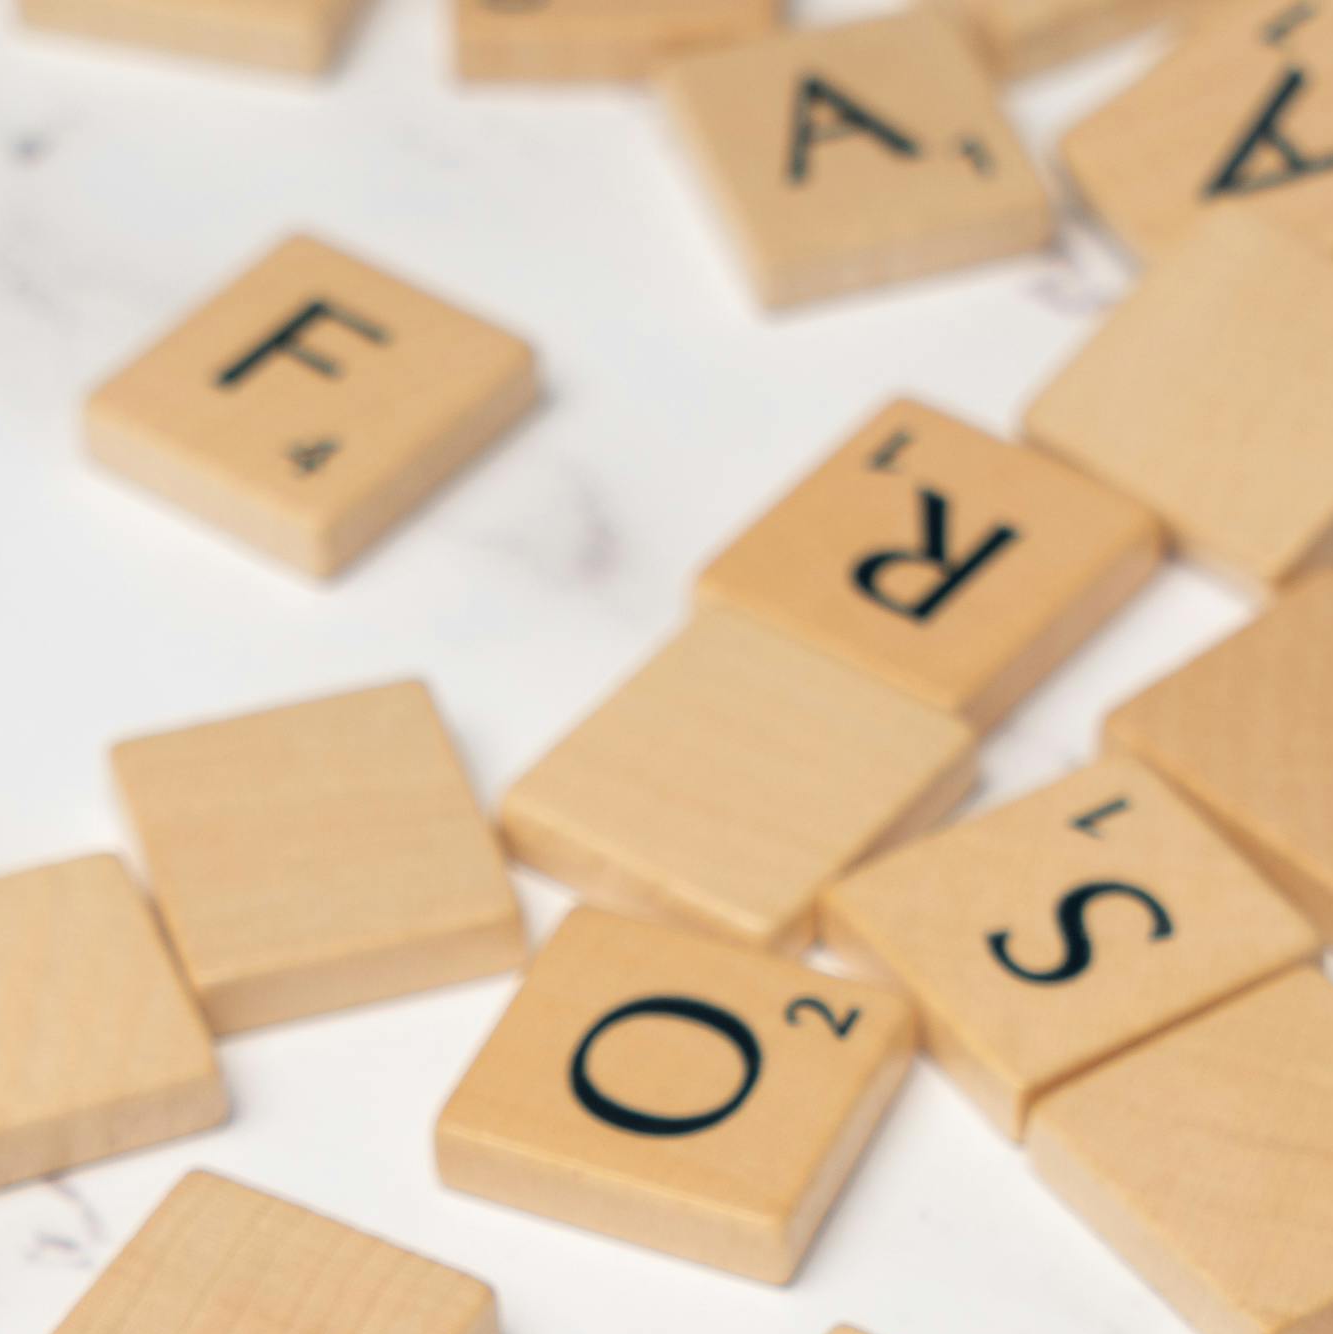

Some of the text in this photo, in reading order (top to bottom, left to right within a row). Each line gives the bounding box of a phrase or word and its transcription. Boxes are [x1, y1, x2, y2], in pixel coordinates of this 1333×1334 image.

[787, 73, 921, 184] A
[216, 298, 387, 389] F
[849, 487, 1021, 624] R
[986, 797, 1175, 986] S 1
[567, 993, 862, 1140] O 2
